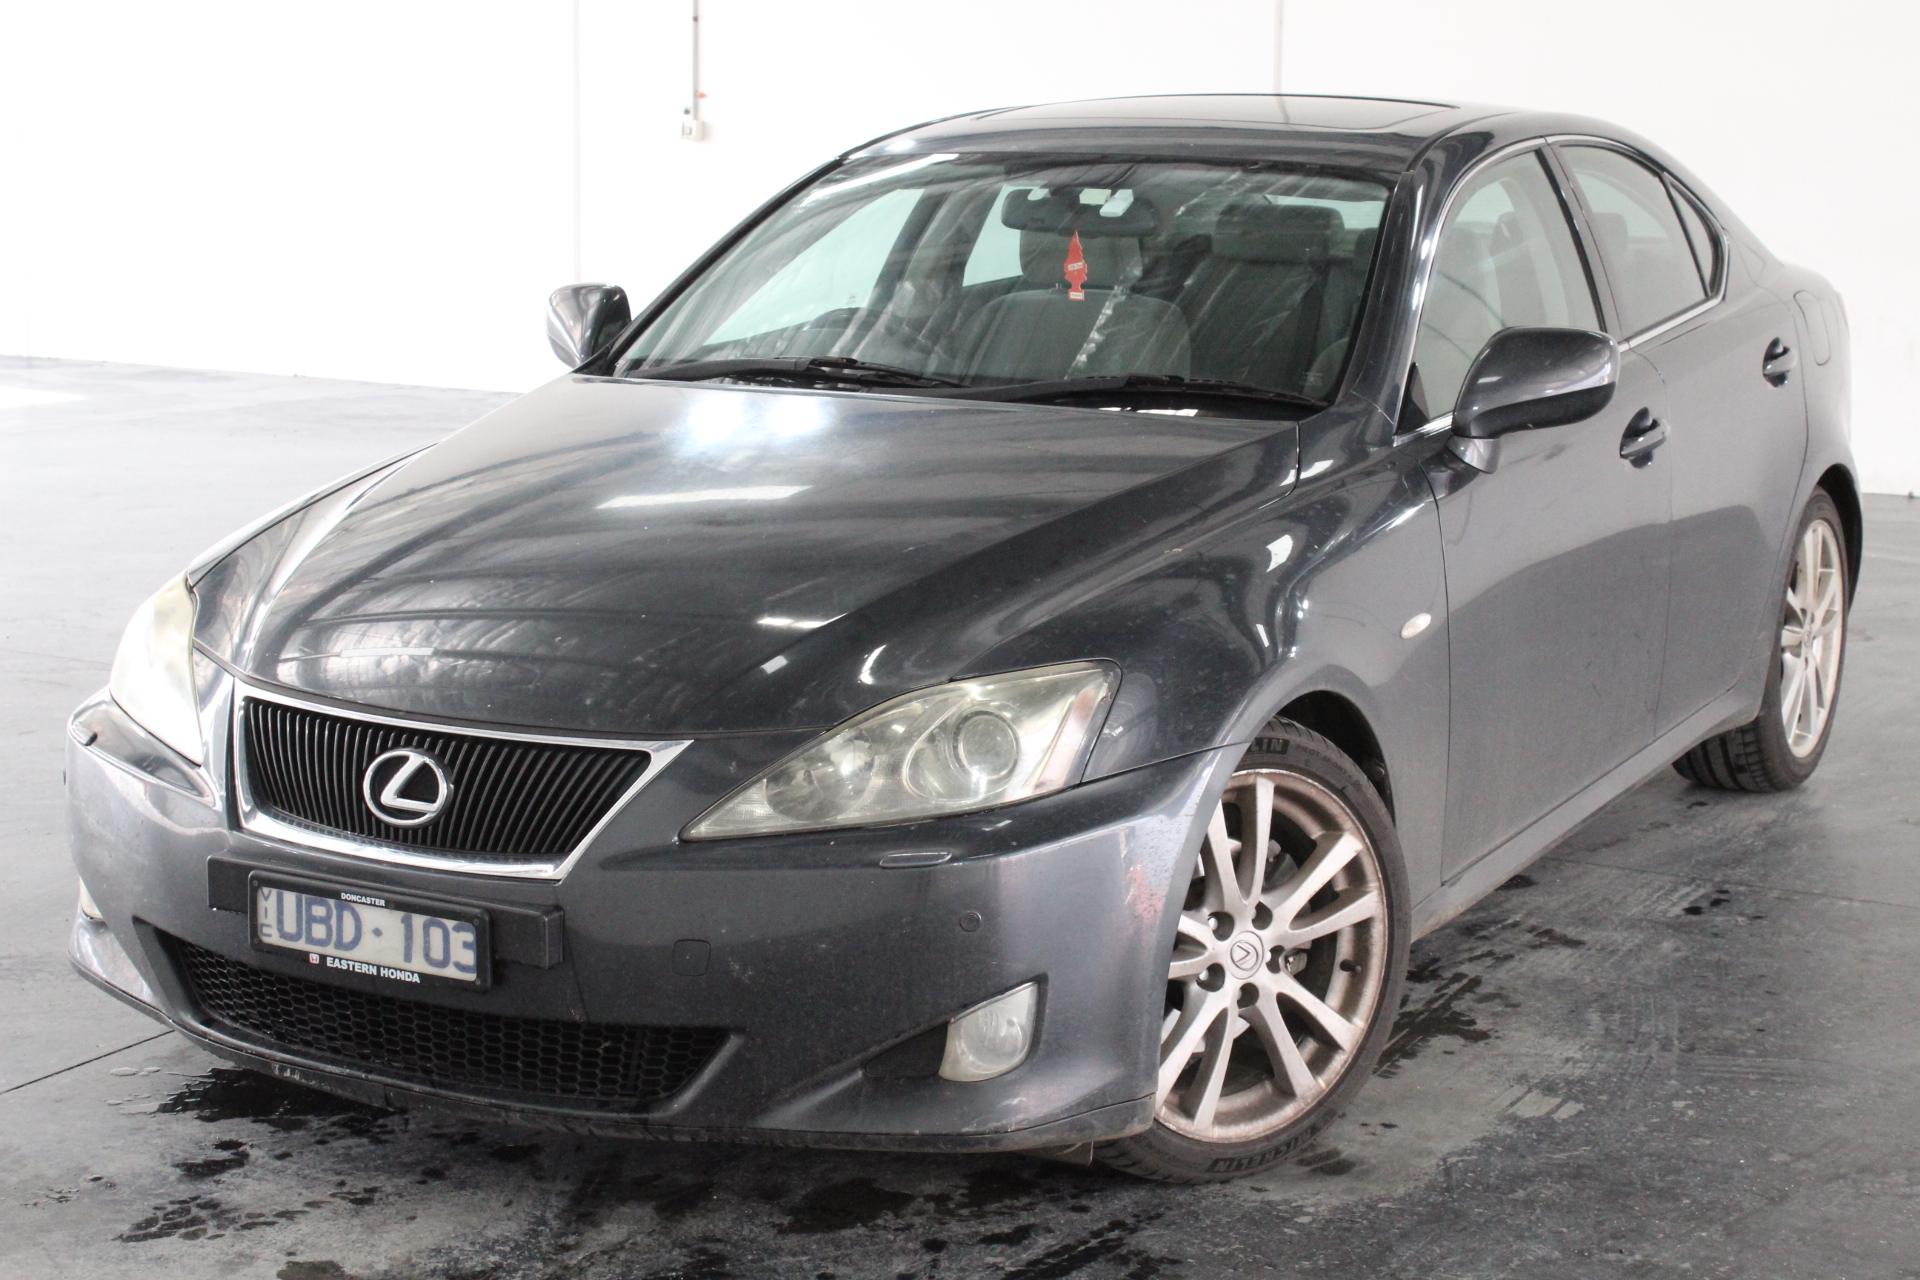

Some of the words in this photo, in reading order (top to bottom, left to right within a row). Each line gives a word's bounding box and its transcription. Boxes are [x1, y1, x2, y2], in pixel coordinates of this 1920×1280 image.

[259, 889, 272, 937] VIC
[341, 892, 386, 907] DONCASTER
[276, 890, 363, 952] UBD
[401, 912, 477, 974] 103
[326, 956, 378, 976] EASTERN
[380, 967, 421, 983] HONDA
